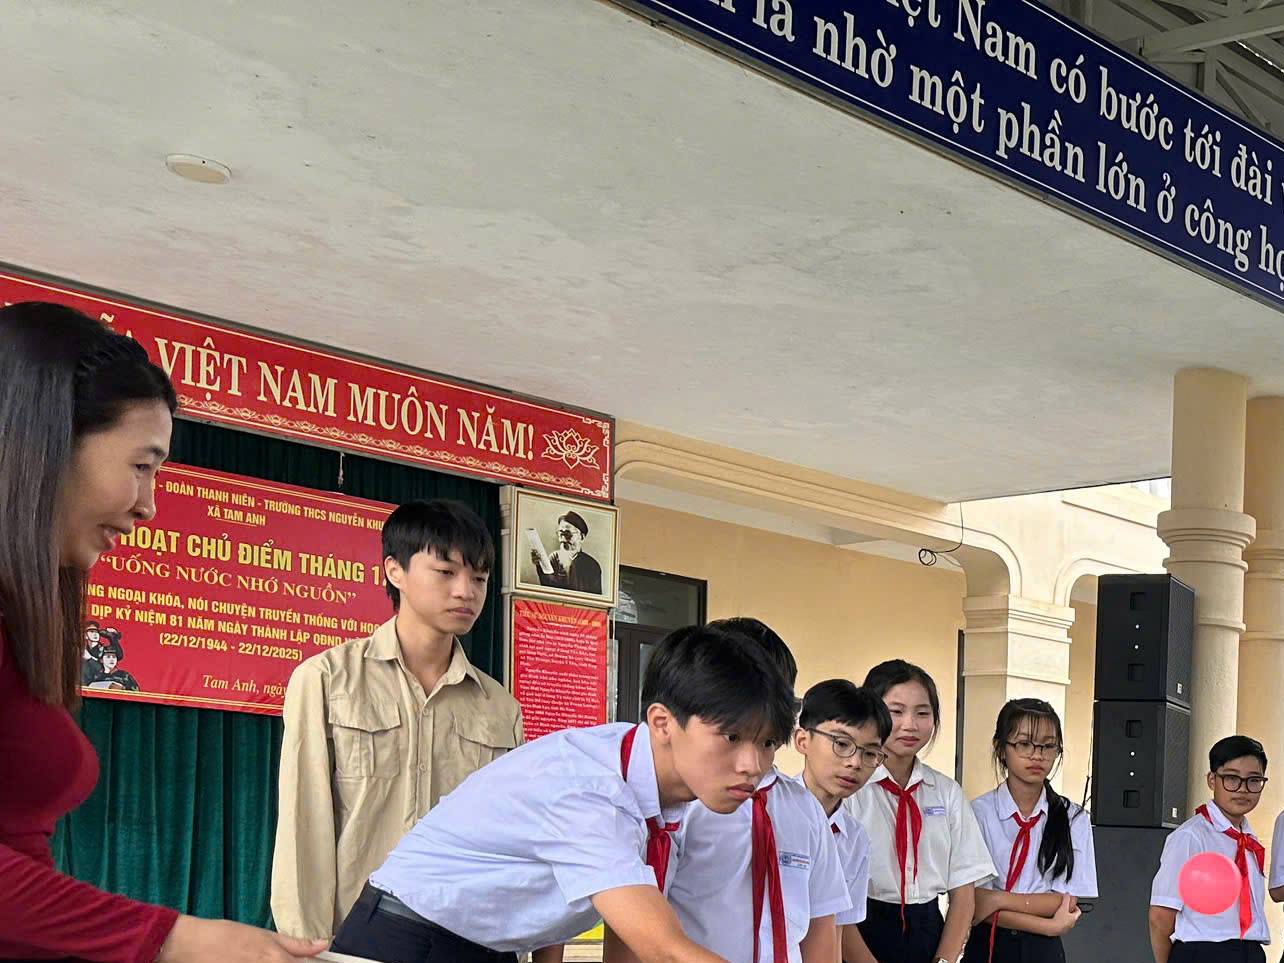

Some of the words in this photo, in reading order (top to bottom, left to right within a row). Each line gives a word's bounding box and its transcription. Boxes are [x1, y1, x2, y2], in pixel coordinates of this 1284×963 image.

[953, 0, 1038, 80] Nam
[1049, 54, 1087, 104] có
[1099, 65, 1174, 150] bước
[1183, 117, 1222, 178] tới
[1230, 143, 1273, 206] đài
[812, 10, 898, 88] nhờ
[908, 64, 985, 134] một
[995, 101, 1086, 184] phần
[1095, 140, 1147, 213] lớn
[1156, 171, 1177, 224] ở
[1184, 198, 1252, 273] công
[154, 336, 248, 401] VIỆT
[256, 360, 338, 418] NAM
[347, 385, 448, 442] MUÔN
[456, 404, 535, 461] NĂM!
[165, 480, 194, 498] ĐOÀN
[197, 487, 229, 501] THANH
[231, 492, 255, 508] NIÊN
[264, 499, 301, 516] TRƯỜNG
[303, 507, 327, 521] THCS
[366, 518, 384, 532] KHU
[207, 504, 221, 518] XÃ
[223, 509, 243, 522] TAM
[245, 512, 266, 526] ANH
[175, 565, 234, 587] NƯỚC
[236, 574, 279, 594] NHỚ
[187, 532, 232, 562] CHỦ
[237, 539, 292, 572] ĐIỂM
[298, 553, 365, 584] THÁNG
[372, 565, 387, 587] 1
[87, 583, 105, 598] NG
[107, 586, 146, 607] NGOẠI
[187, 596, 209, 611] NÓI
[211, 600, 257, 621] CHUYỆN
[304, 611, 338, 630] THỐNG
[340, 617, 358, 632] VỚI
[91, 604, 112, 621] DỊP
[115, 603, 132, 621] KỶ
[135, 609, 167, 626] NIỆM
[169, 615, 183, 628] 81
[187, 616, 215, 632] NĂM
[217, 619, 248, 636] NGÀY
[251, 625, 288, 641] THÀNH
[290, 629, 311, 645] LẬP
[159, 632, 228, 652] (22/12/1944
[238, 641, 303, 662] 22/12/2025)
[203, 674, 229, 690] Tam
[231, 678, 260, 695] Anh,
